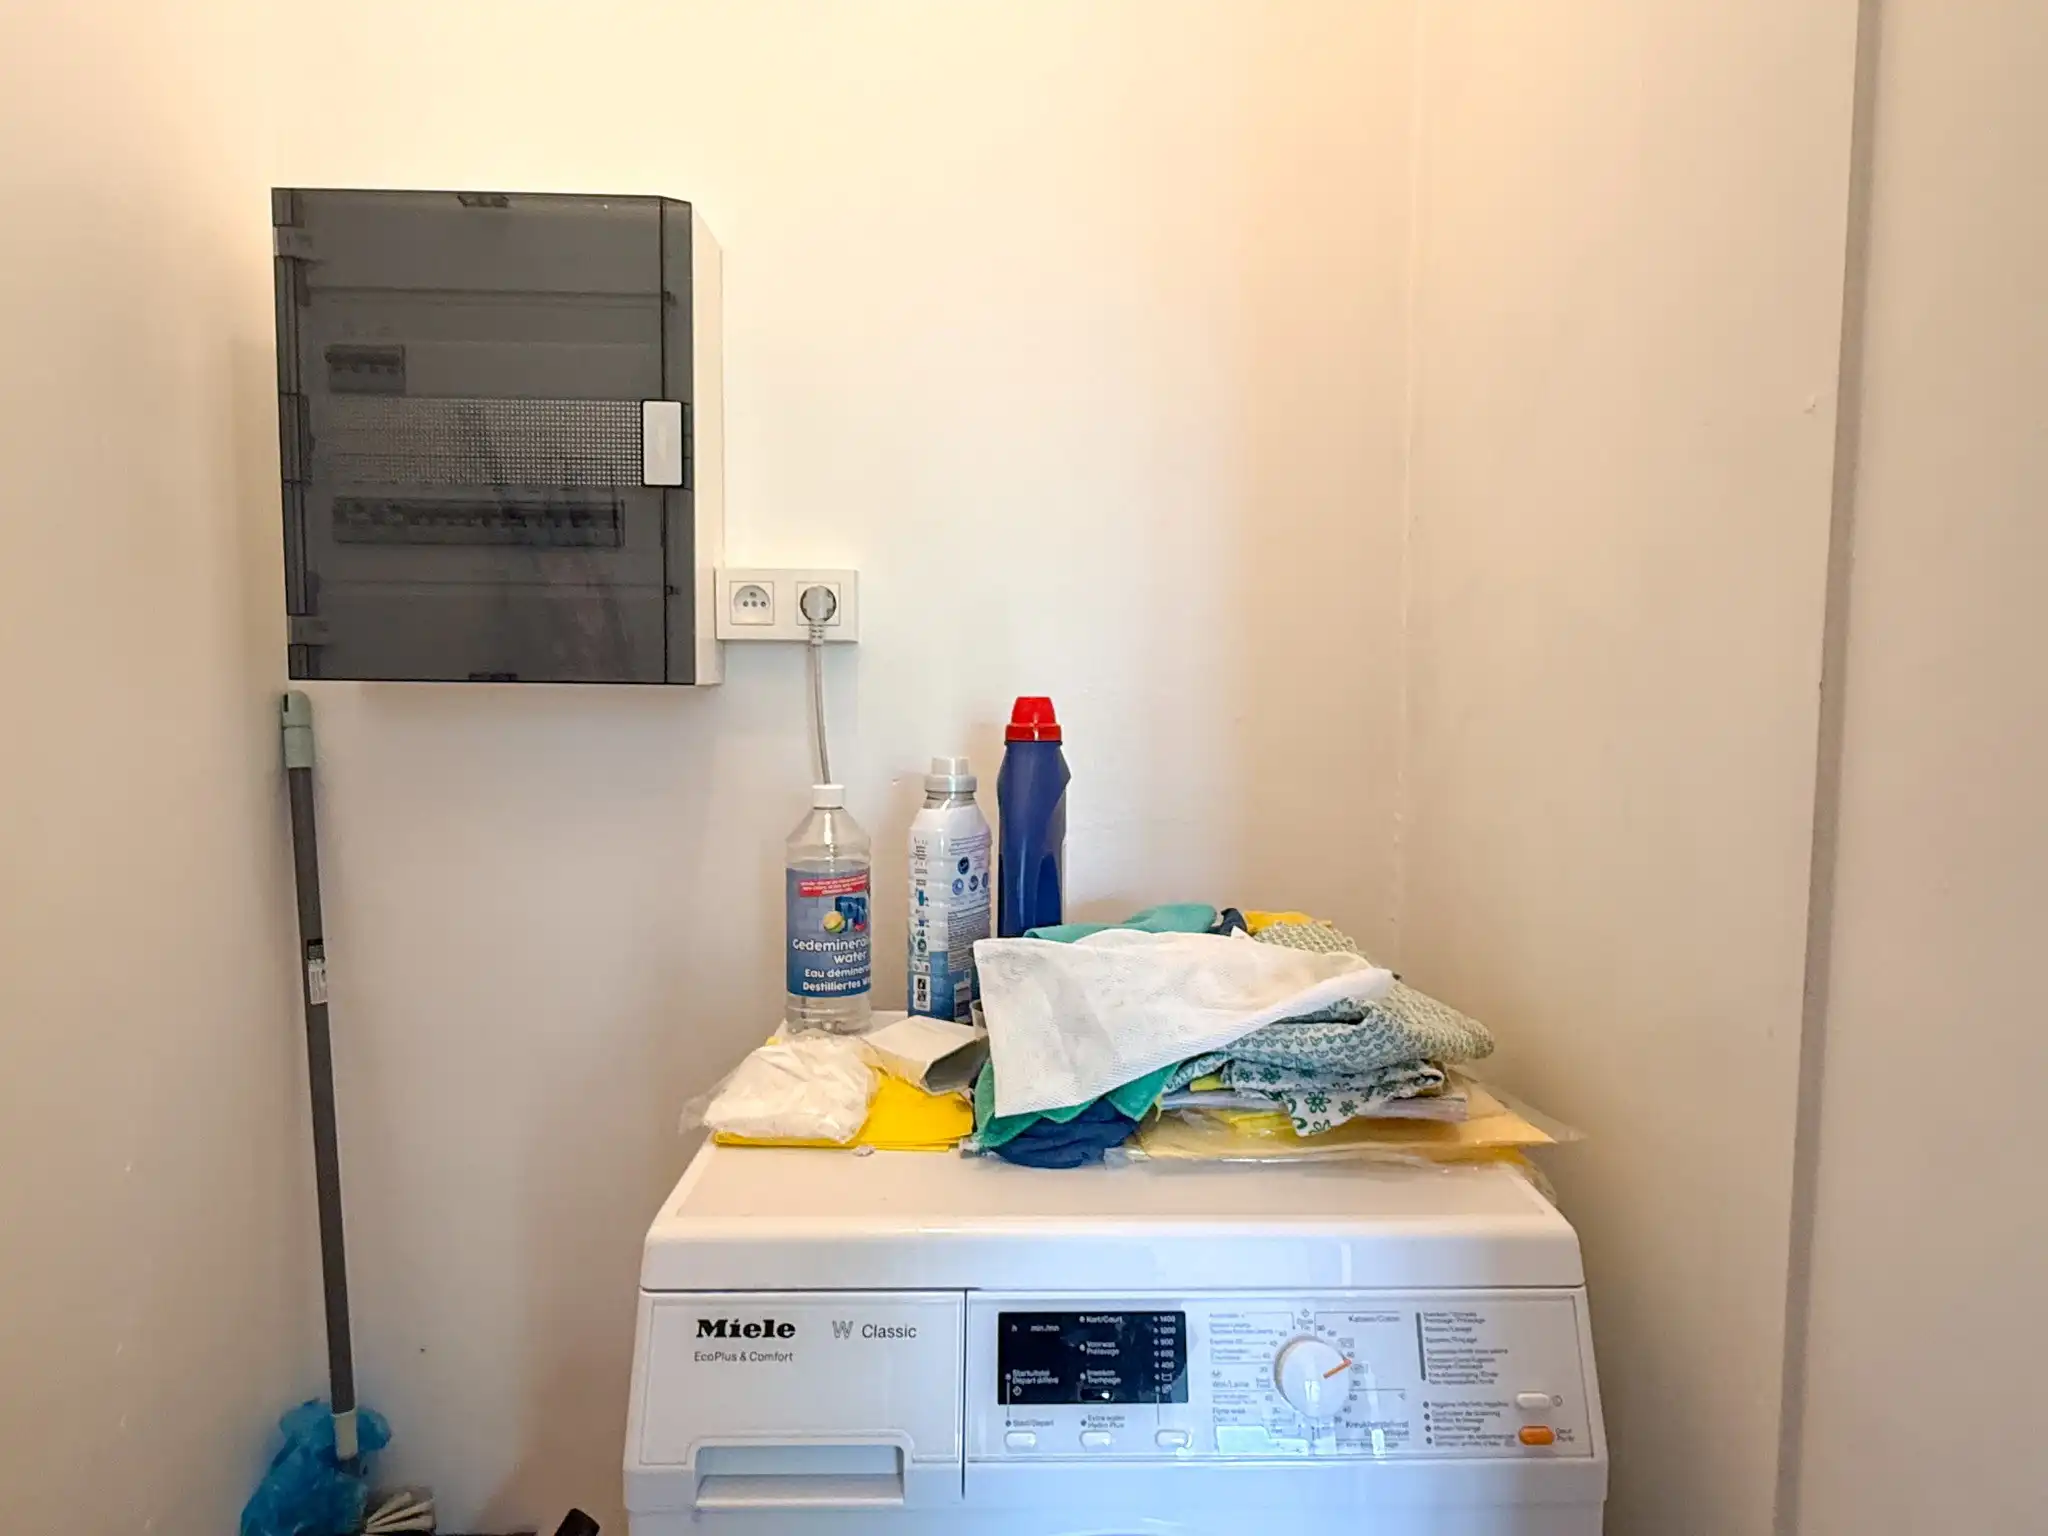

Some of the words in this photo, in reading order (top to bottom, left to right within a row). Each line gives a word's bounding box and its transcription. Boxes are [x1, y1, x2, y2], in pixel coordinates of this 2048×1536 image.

[833, 950, 867, 965] water
[804, 968, 825, 979] Eau
[802, 980, 861, 992] Destilliertes
[696, 1318, 796, 1339] Miele
[861, 1323, 917, 1339] Classic
[694, 1351, 738, 1363] EcoPlus
[739, 1351, 747, 1363] &
[749, 1351, 794, 1363] Comfort
